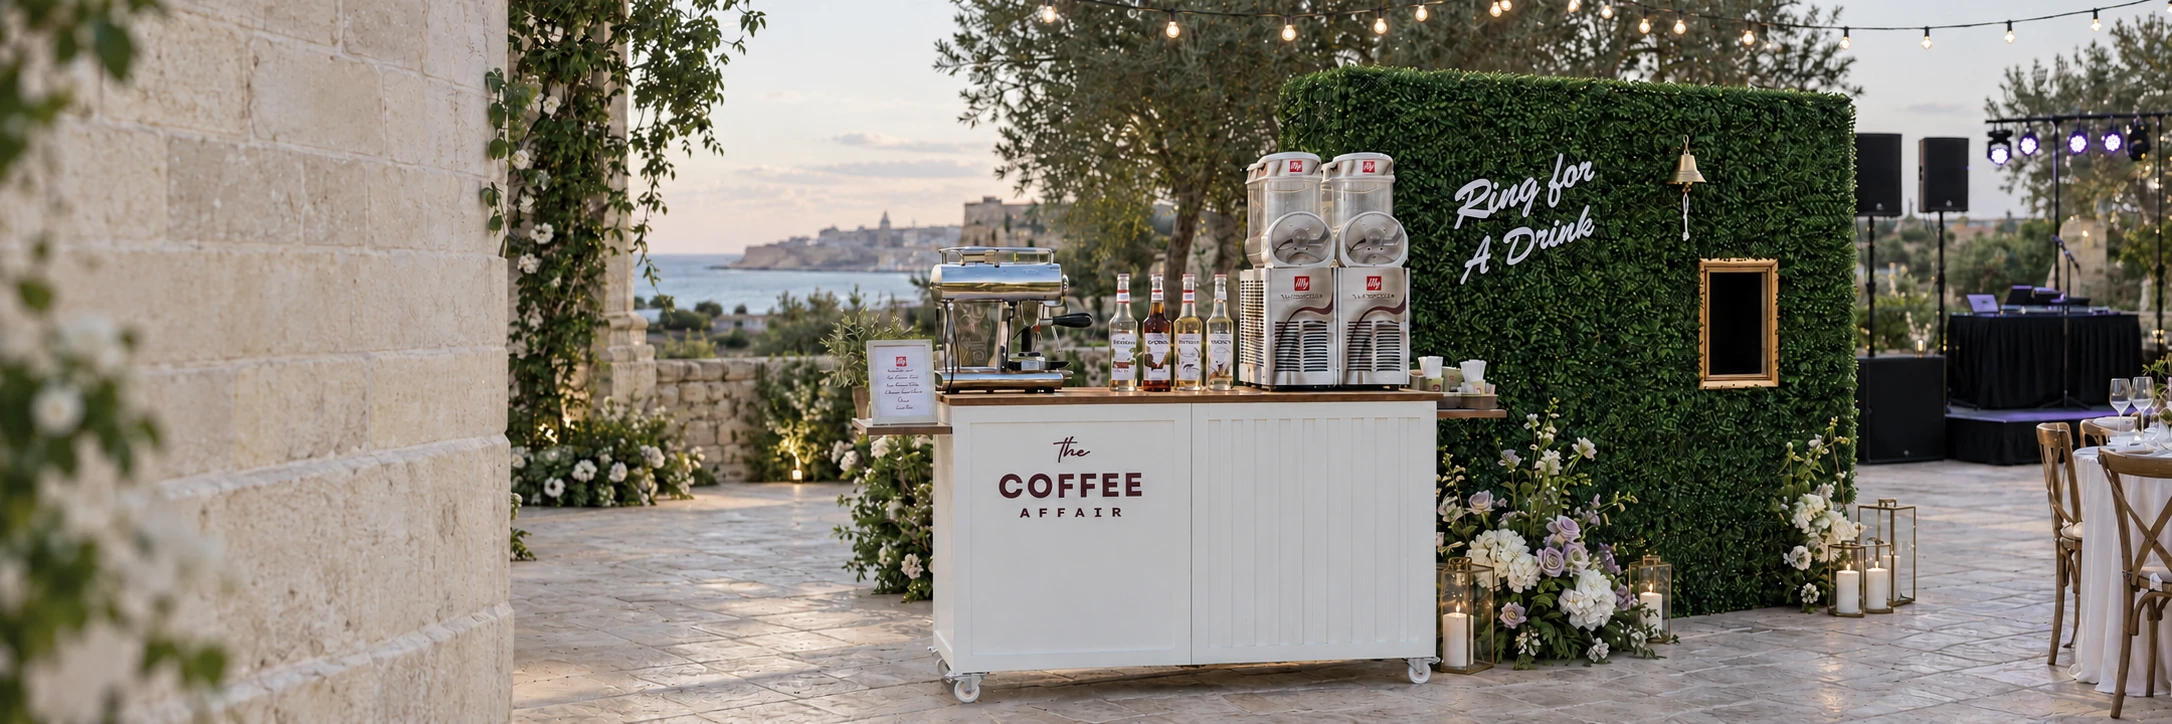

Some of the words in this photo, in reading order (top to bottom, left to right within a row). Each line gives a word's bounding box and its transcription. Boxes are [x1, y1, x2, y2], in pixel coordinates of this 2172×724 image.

[1453, 176, 1541, 230] Ring
[1547, 152, 1596, 208] for
[1459, 234, 1492, 286] A
[1502, 204, 1596, 266] Drink
[1052, 435, 1091, 463] the
[998, 472, 1143, 499] COFFEE
[1019, 507, 1122, 519] AFFAIR
